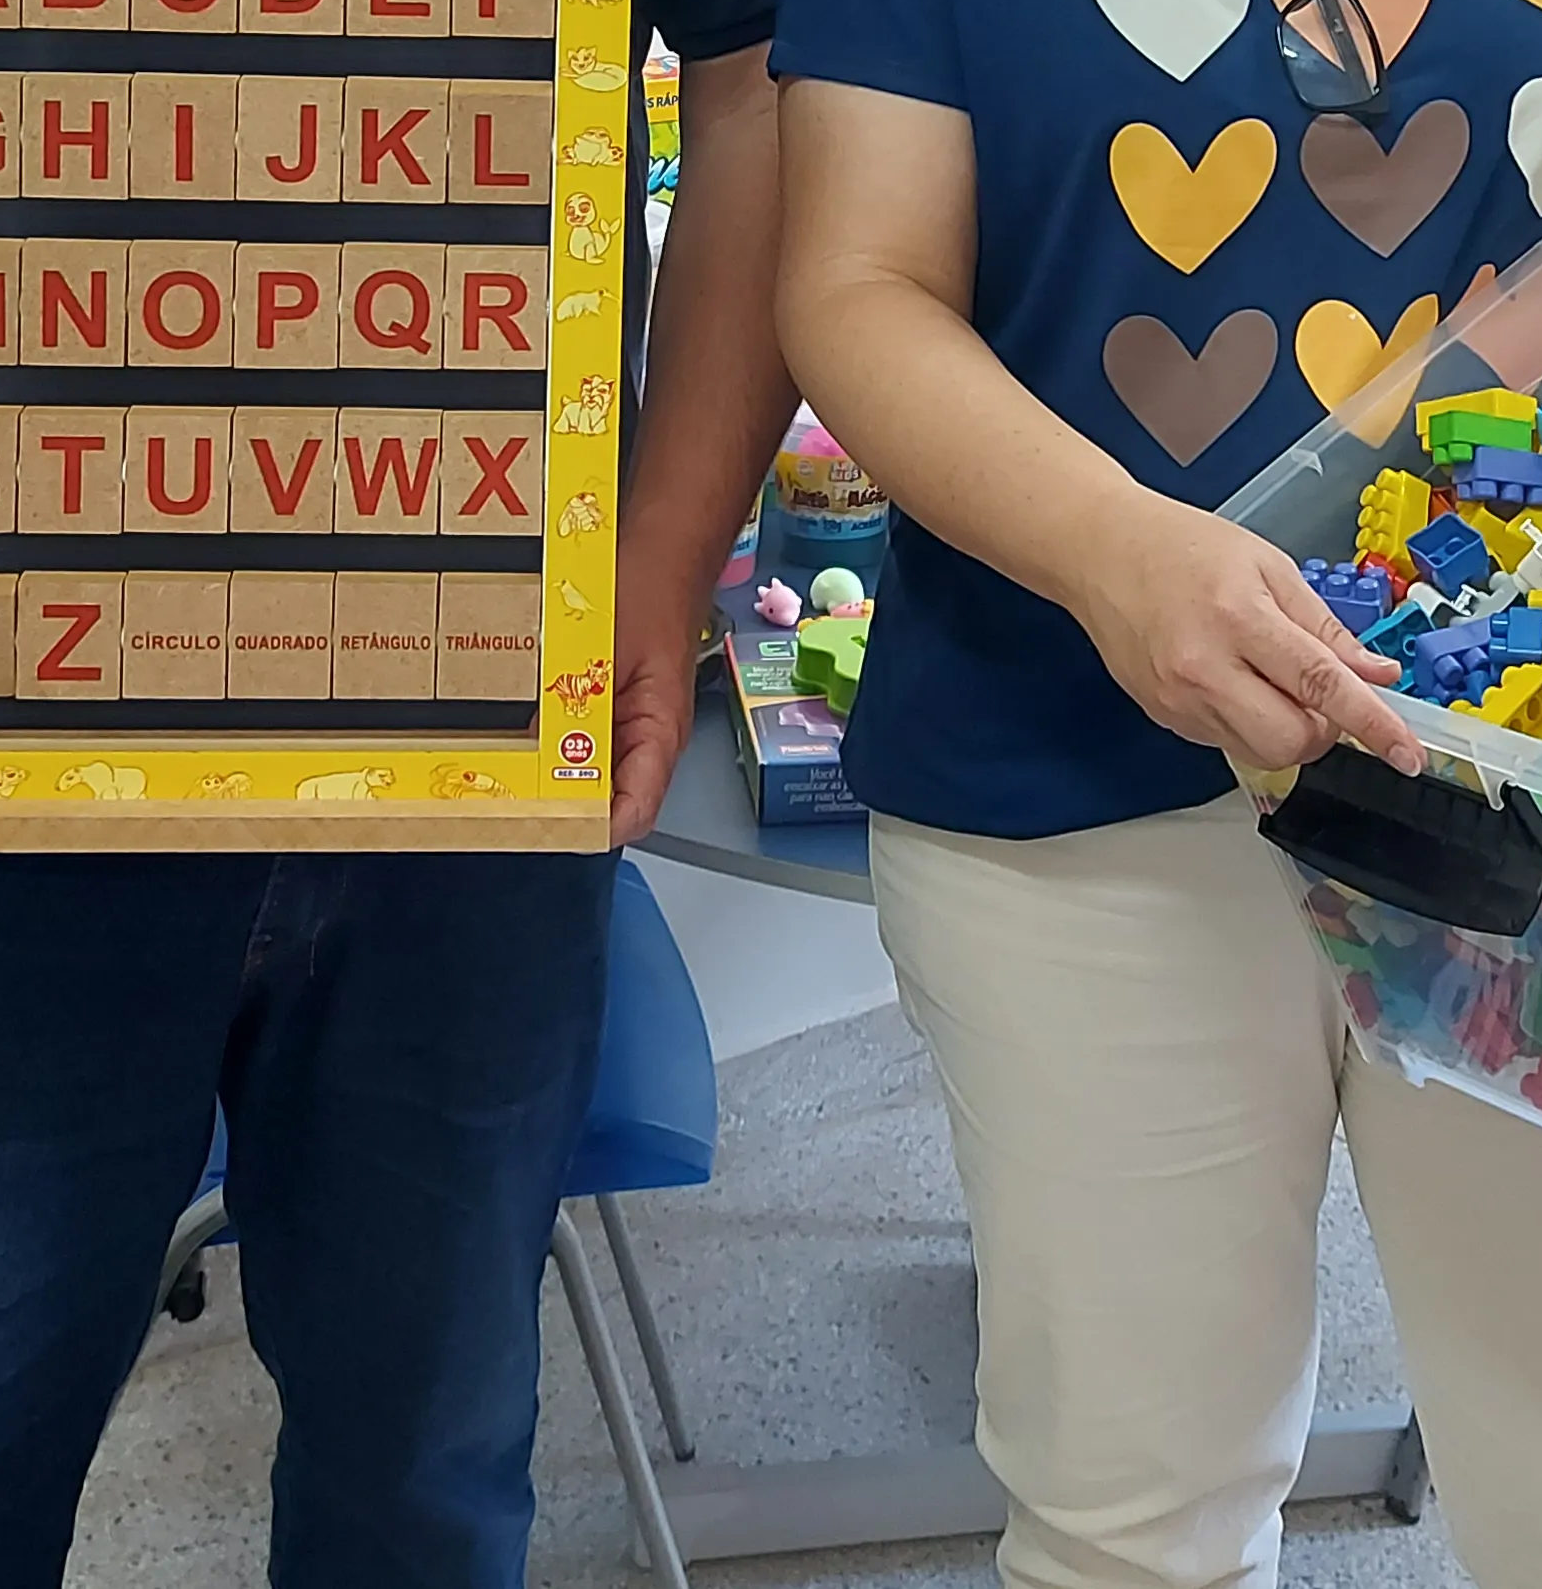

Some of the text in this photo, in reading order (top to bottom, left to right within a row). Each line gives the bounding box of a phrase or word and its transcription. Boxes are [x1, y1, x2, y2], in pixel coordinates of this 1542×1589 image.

[42, 100, 109, 180] H
[174, 104, 194, 183] I
[266, 105, 318, 184] J
[360, 109, 430, 186] K
[474, 114, 530, 187] L
[41, 269, 107, 349] N
[141, 271, 221, 351] O
[256, 271, 320, 350] P
[353, 269, 432, 355] Q
[462, 272, 531, 352] R
[40, 435, 105, 515] T
[146, 437, 212, 516] U
[252, 438, 322, 517] V
[343, 436, 439, 517] W
[460, 436, 528, 517] X
[36, 603, 102, 682] Z
[131, 631, 221, 651] CÍRCULO
[234, 635, 328, 651] QUADRADO
[340, 631, 431, 651] RETÂNGULO
[445, 632, 535, 652] TRIÂNGULO
